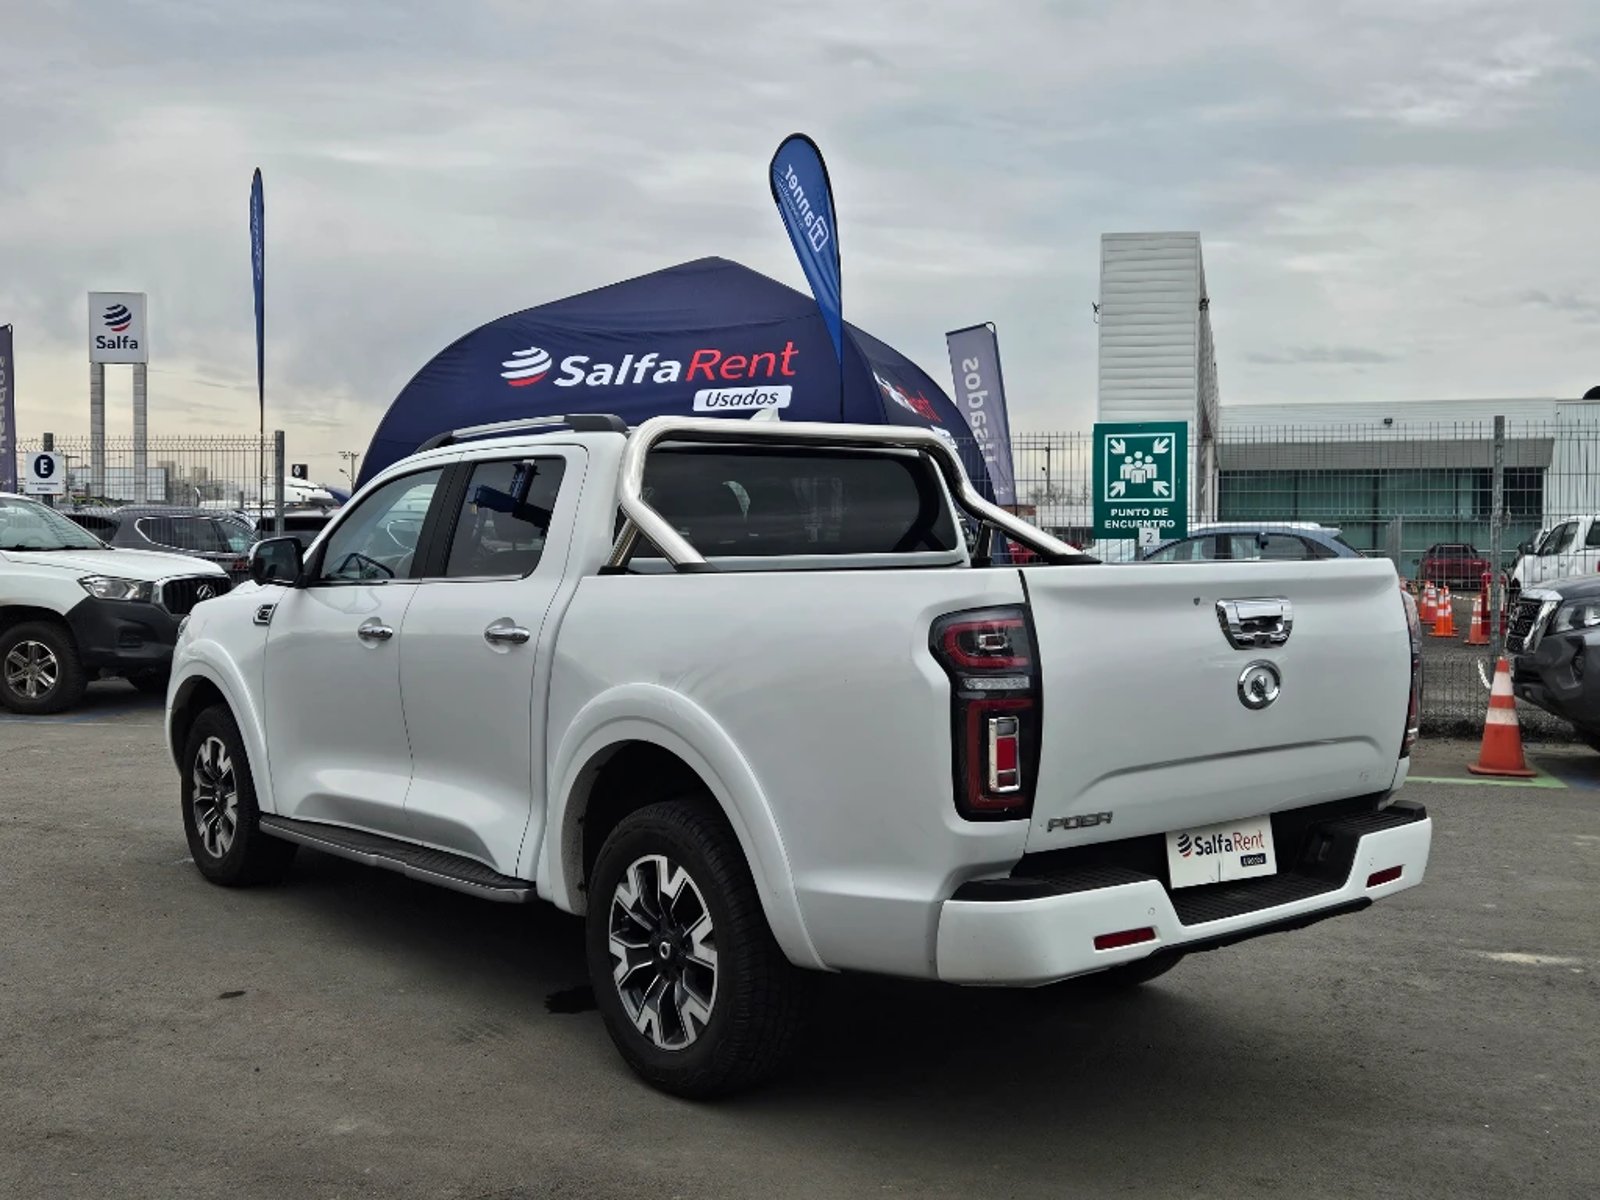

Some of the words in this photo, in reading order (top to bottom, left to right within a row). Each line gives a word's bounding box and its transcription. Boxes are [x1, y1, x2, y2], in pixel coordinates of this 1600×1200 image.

[96, 335, 138, 349] Salfa
[554, 340, 799, 387] SalfaRent
[705, 388, 779, 408] Usados
[40, 458, 49, 475] E
[1110, 508, 1151, 517] PUNTO
[1153, 507, 1169, 517] DE
[1104, 519, 1176, 529] ENCUENTRO
[1146, 531, 1154, 544] 2
[1194, 829, 1265, 856] SalfaRent
